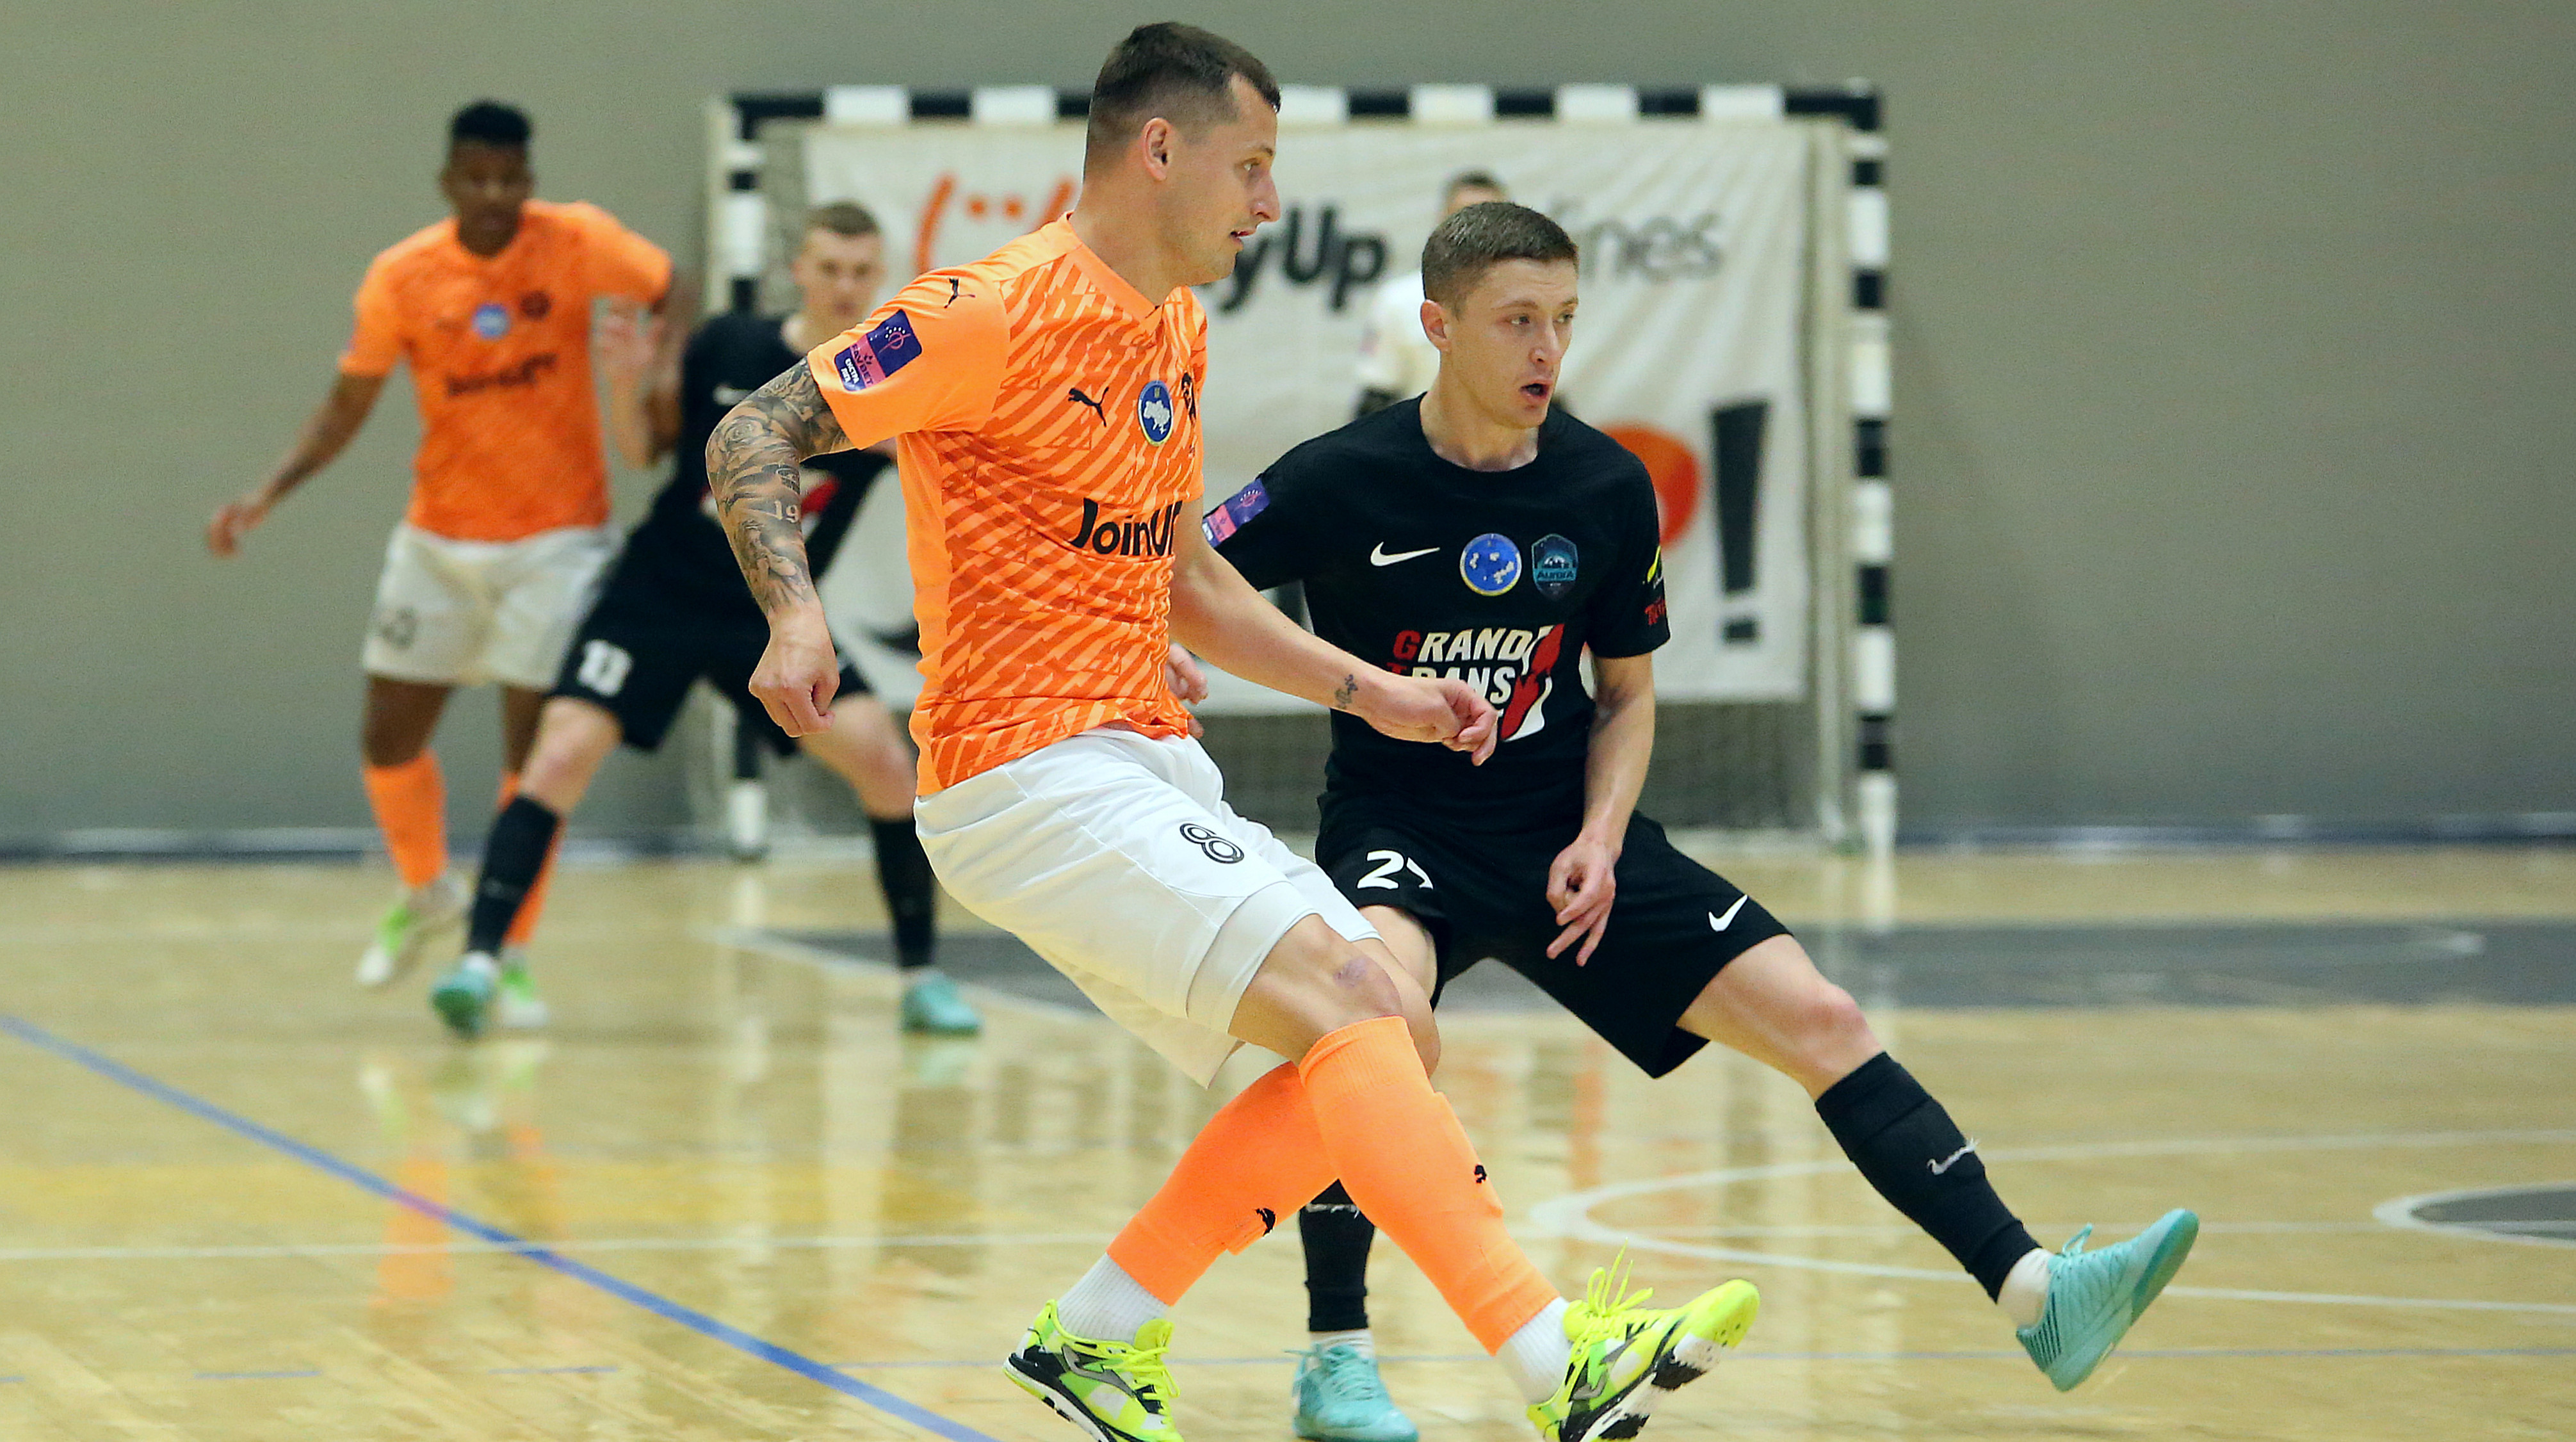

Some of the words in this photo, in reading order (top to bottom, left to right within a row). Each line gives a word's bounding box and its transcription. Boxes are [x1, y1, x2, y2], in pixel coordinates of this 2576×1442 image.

[1220, 206, 1385, 312] yUp
[852, 344, 873, 384] FAVBET
[1393, 628, 1533, 662] GRAND
[1179, 823, 1244, 864] 8
